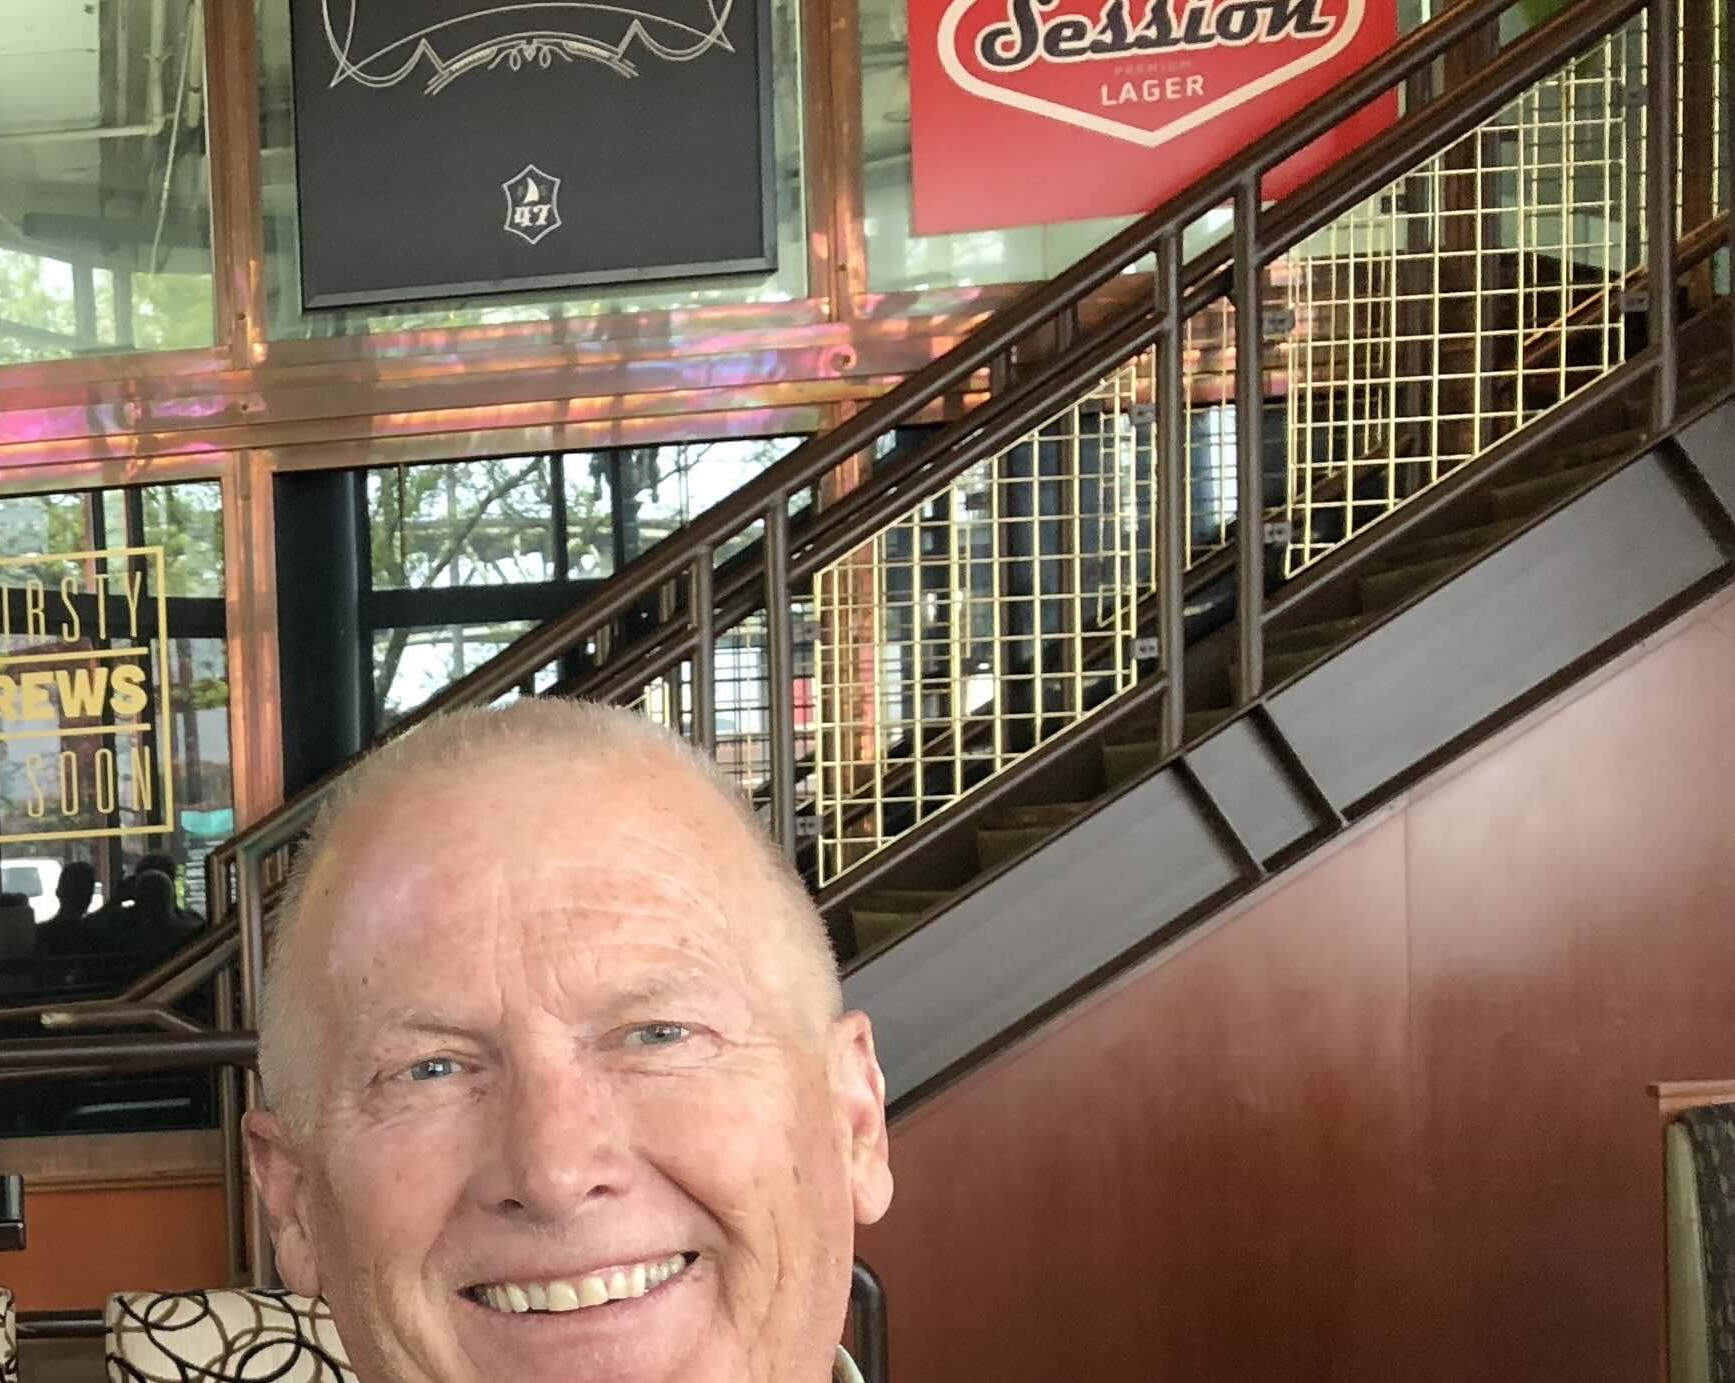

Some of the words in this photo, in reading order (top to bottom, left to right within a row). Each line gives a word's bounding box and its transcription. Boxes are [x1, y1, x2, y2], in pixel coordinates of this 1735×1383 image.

[979, 0, 1330, 68] Session
[1101, 75, 1204, 106] LAGER
[514, 204, 552, 227] 47
[26, 745, 152, 818] SOON
